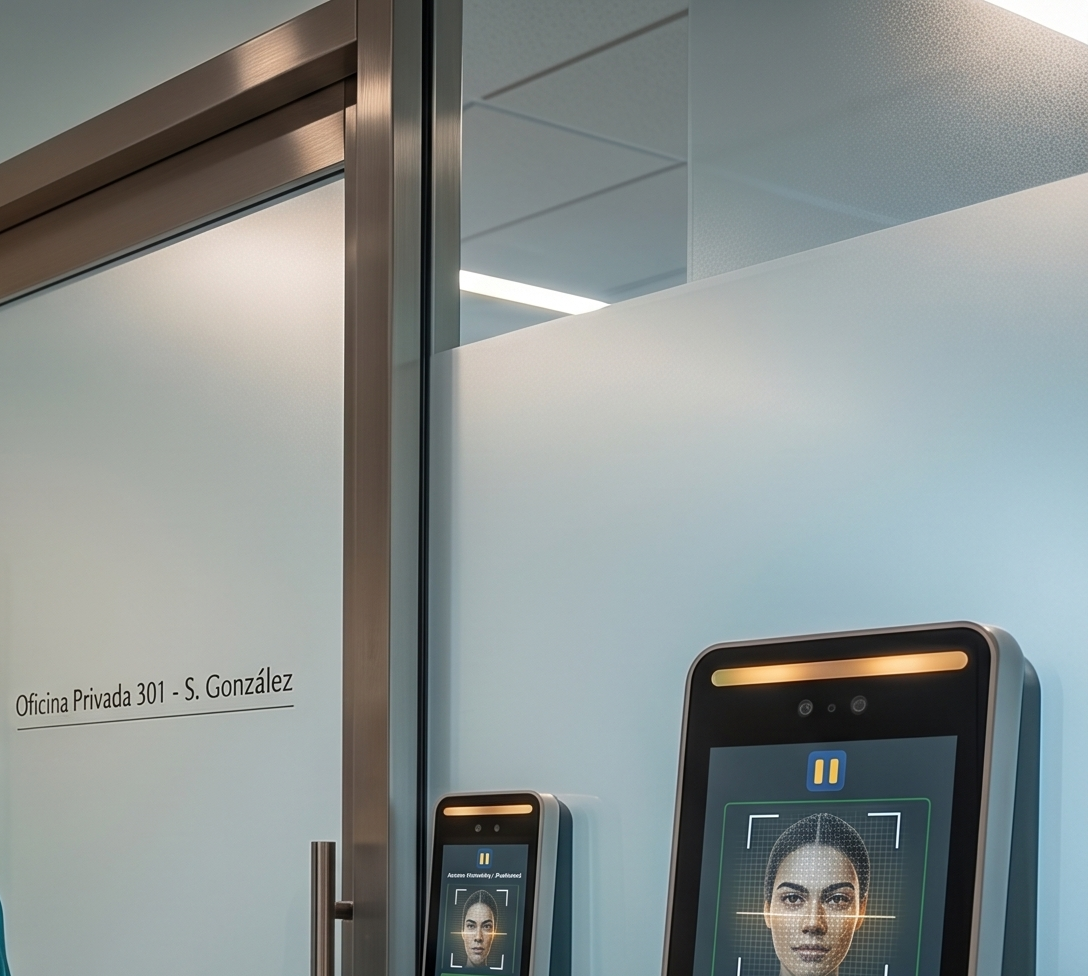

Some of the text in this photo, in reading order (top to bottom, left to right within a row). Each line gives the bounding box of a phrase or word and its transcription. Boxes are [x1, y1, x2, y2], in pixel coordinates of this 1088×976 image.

[15, 691, 69, 717] Oficina
[73, 682, 132, 712] Privada
[136, 680, 164, 706] 301
[184, 676, 200, 702] S.
[205, 666, 294, 699] González
